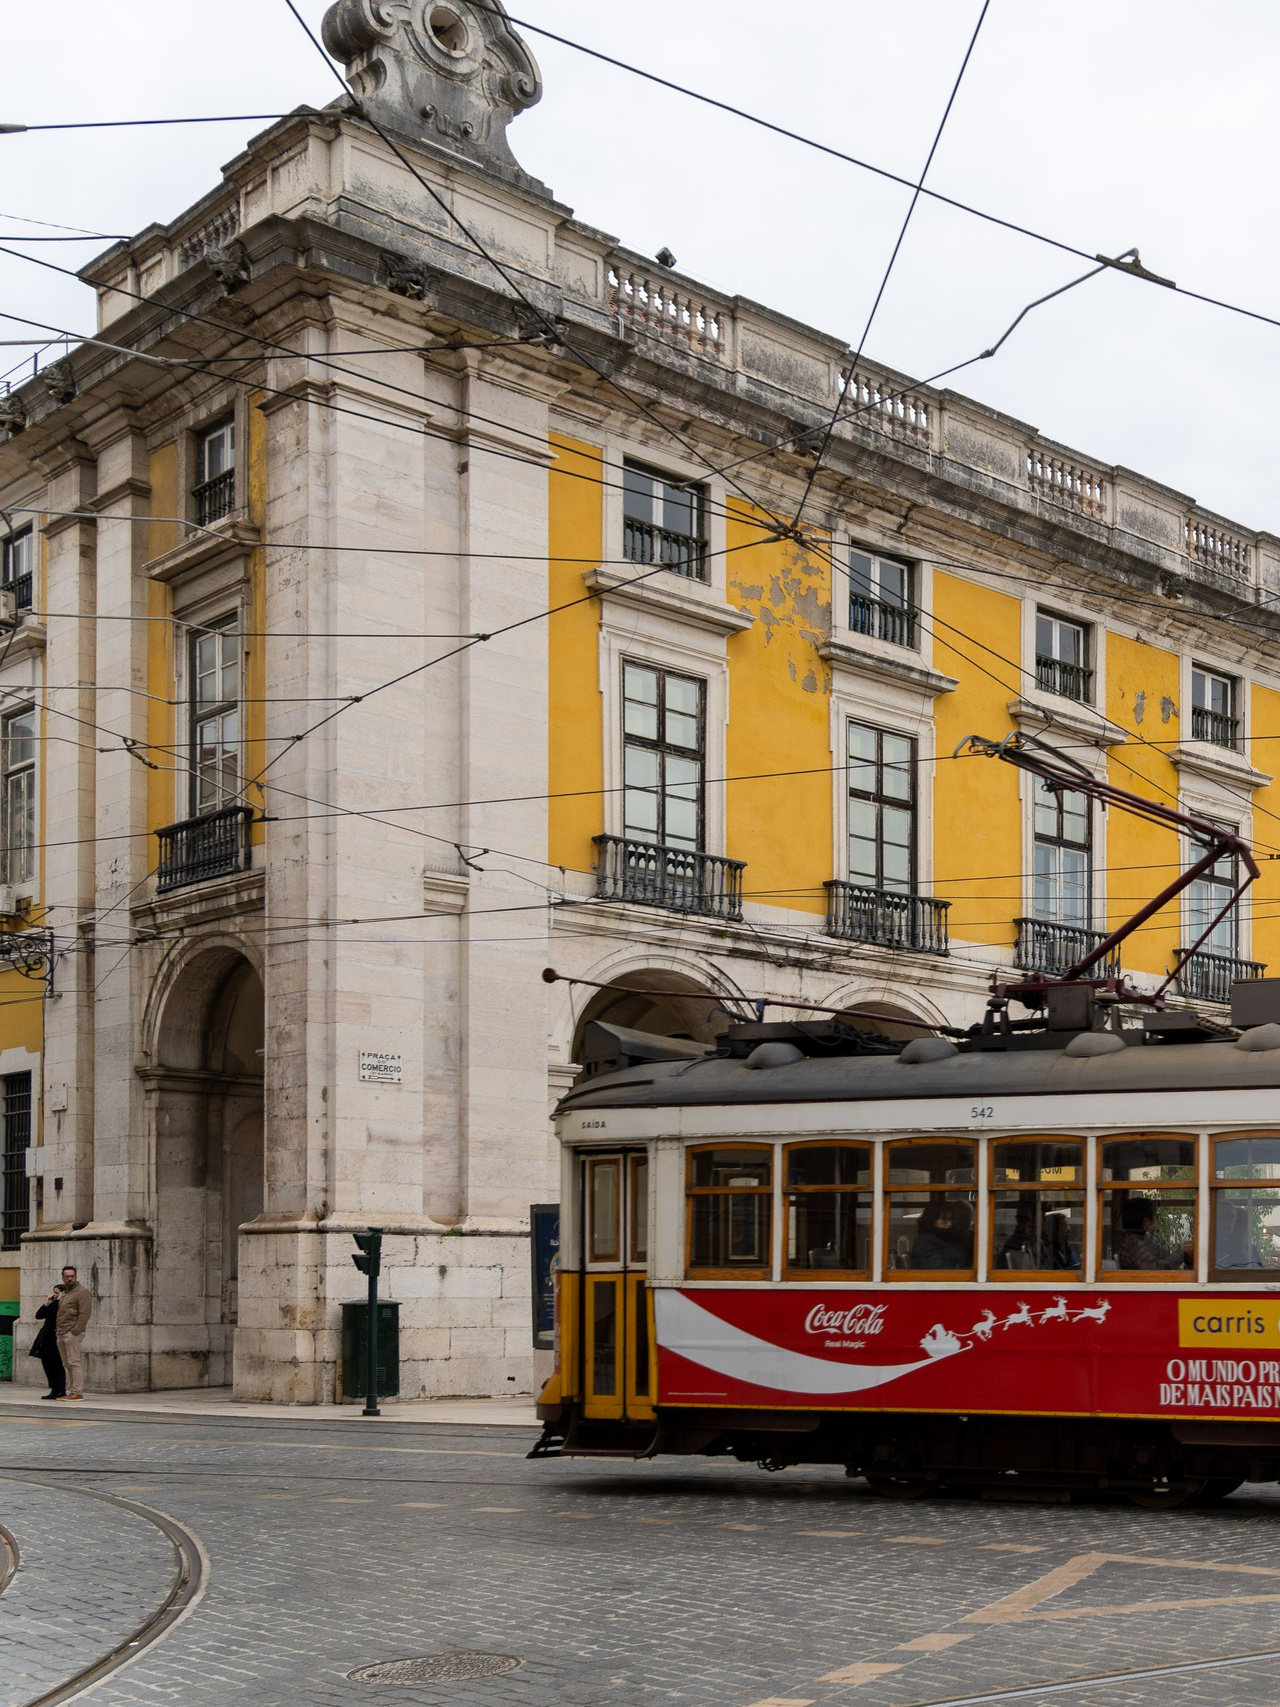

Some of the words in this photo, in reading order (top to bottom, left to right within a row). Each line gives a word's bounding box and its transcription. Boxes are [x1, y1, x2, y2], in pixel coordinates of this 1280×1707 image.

[367, 1052, 396, 1061] PRAÇA
[361, 1063, 402, 1073] COMERCIO
[971, 1106, 994, 1118] 542
[581, 1119, 606, 1129] SAÍDA
[805, 1303, 889, 1334] Coca-Cola
[1193, 1309, 1265, 1334] carris
[1166, 1359, 1186, 1382] O
[1188, 1359, 1257, 1383] MUNDO
[1159, 1383, 1185, 1406] DE
[1187, 1384, 1231, 1407] MAIS
[1232, 1385, 1272, 1408] PAIS
